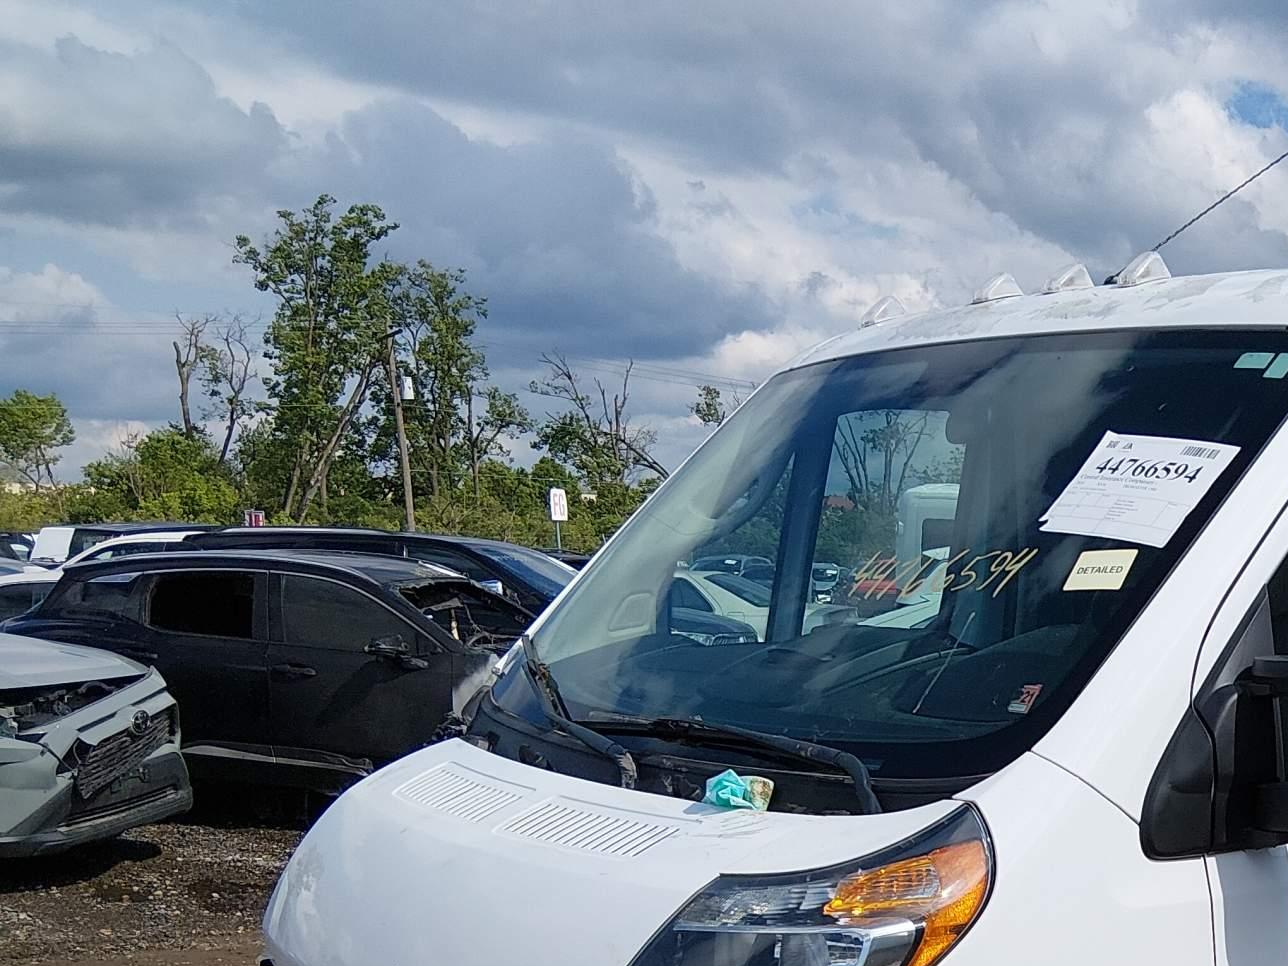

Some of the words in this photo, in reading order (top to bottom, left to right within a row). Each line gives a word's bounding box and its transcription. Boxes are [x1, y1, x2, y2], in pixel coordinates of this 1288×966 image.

[1096, 456, 1204, 484] 44766594
[552, 493, 566, 516] FG
[1076, 565, 1124, 575] DETAILED
